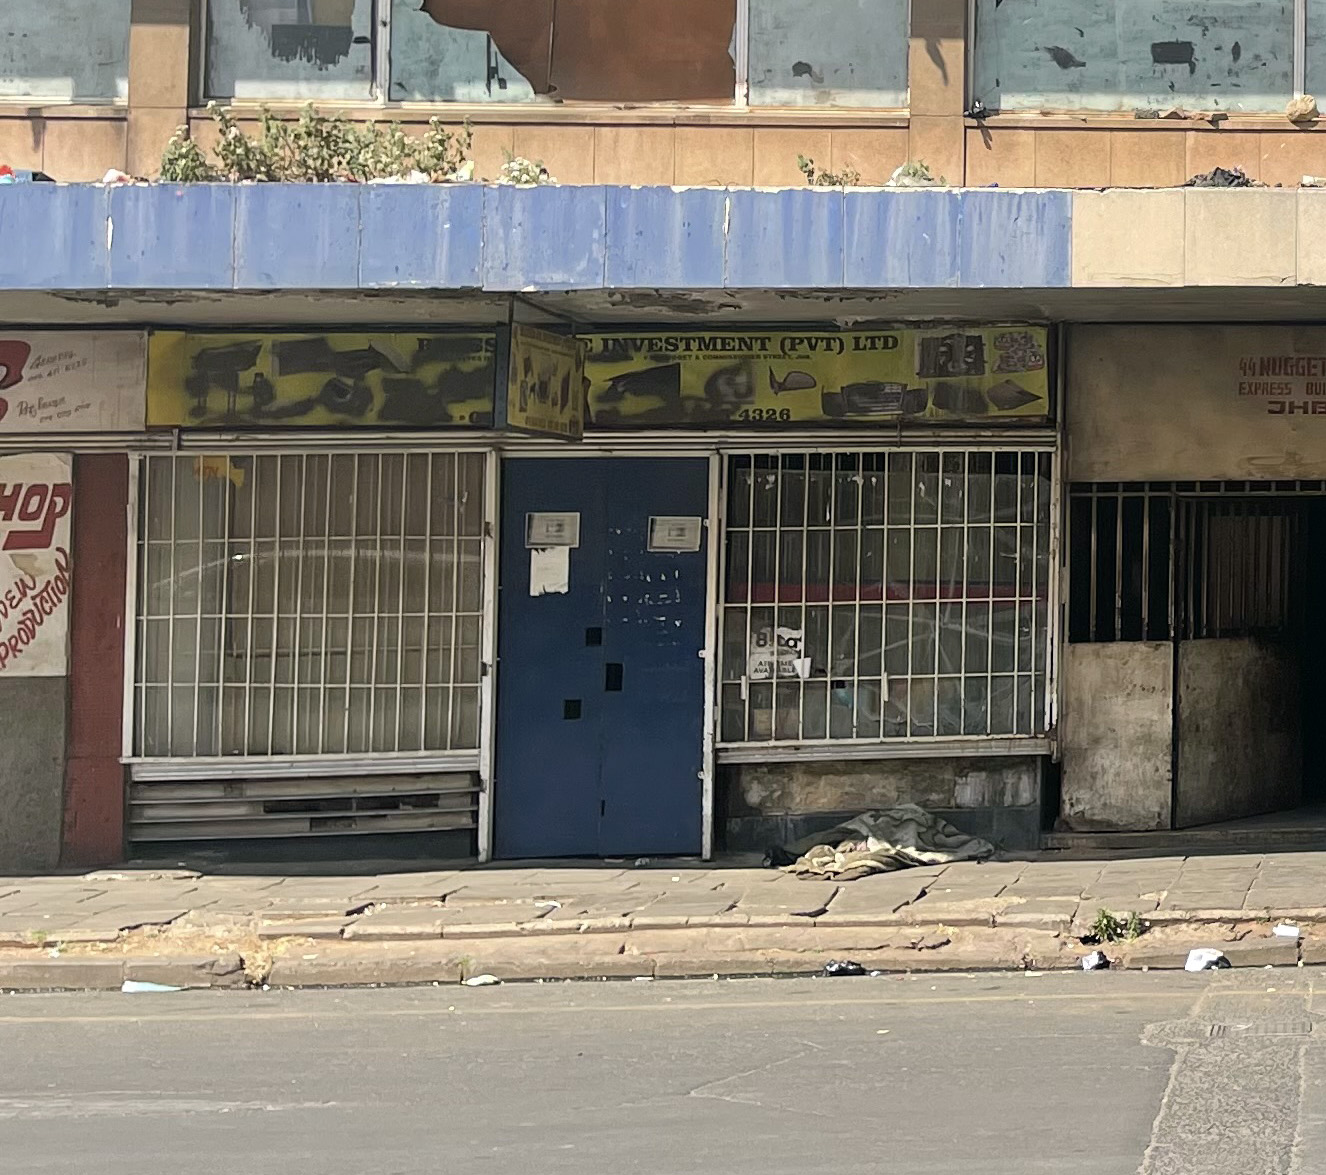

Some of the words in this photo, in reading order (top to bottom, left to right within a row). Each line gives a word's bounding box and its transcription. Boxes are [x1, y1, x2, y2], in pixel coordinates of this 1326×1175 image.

[602, 336, 771, 353] INVESTMENT
[779, 335, 845, 355] (PVT)
[851, 335, 899, 351] LTD
[1238, 382, 1292, 396] EXPRESS
[737, 408, 792, 421] 4326
